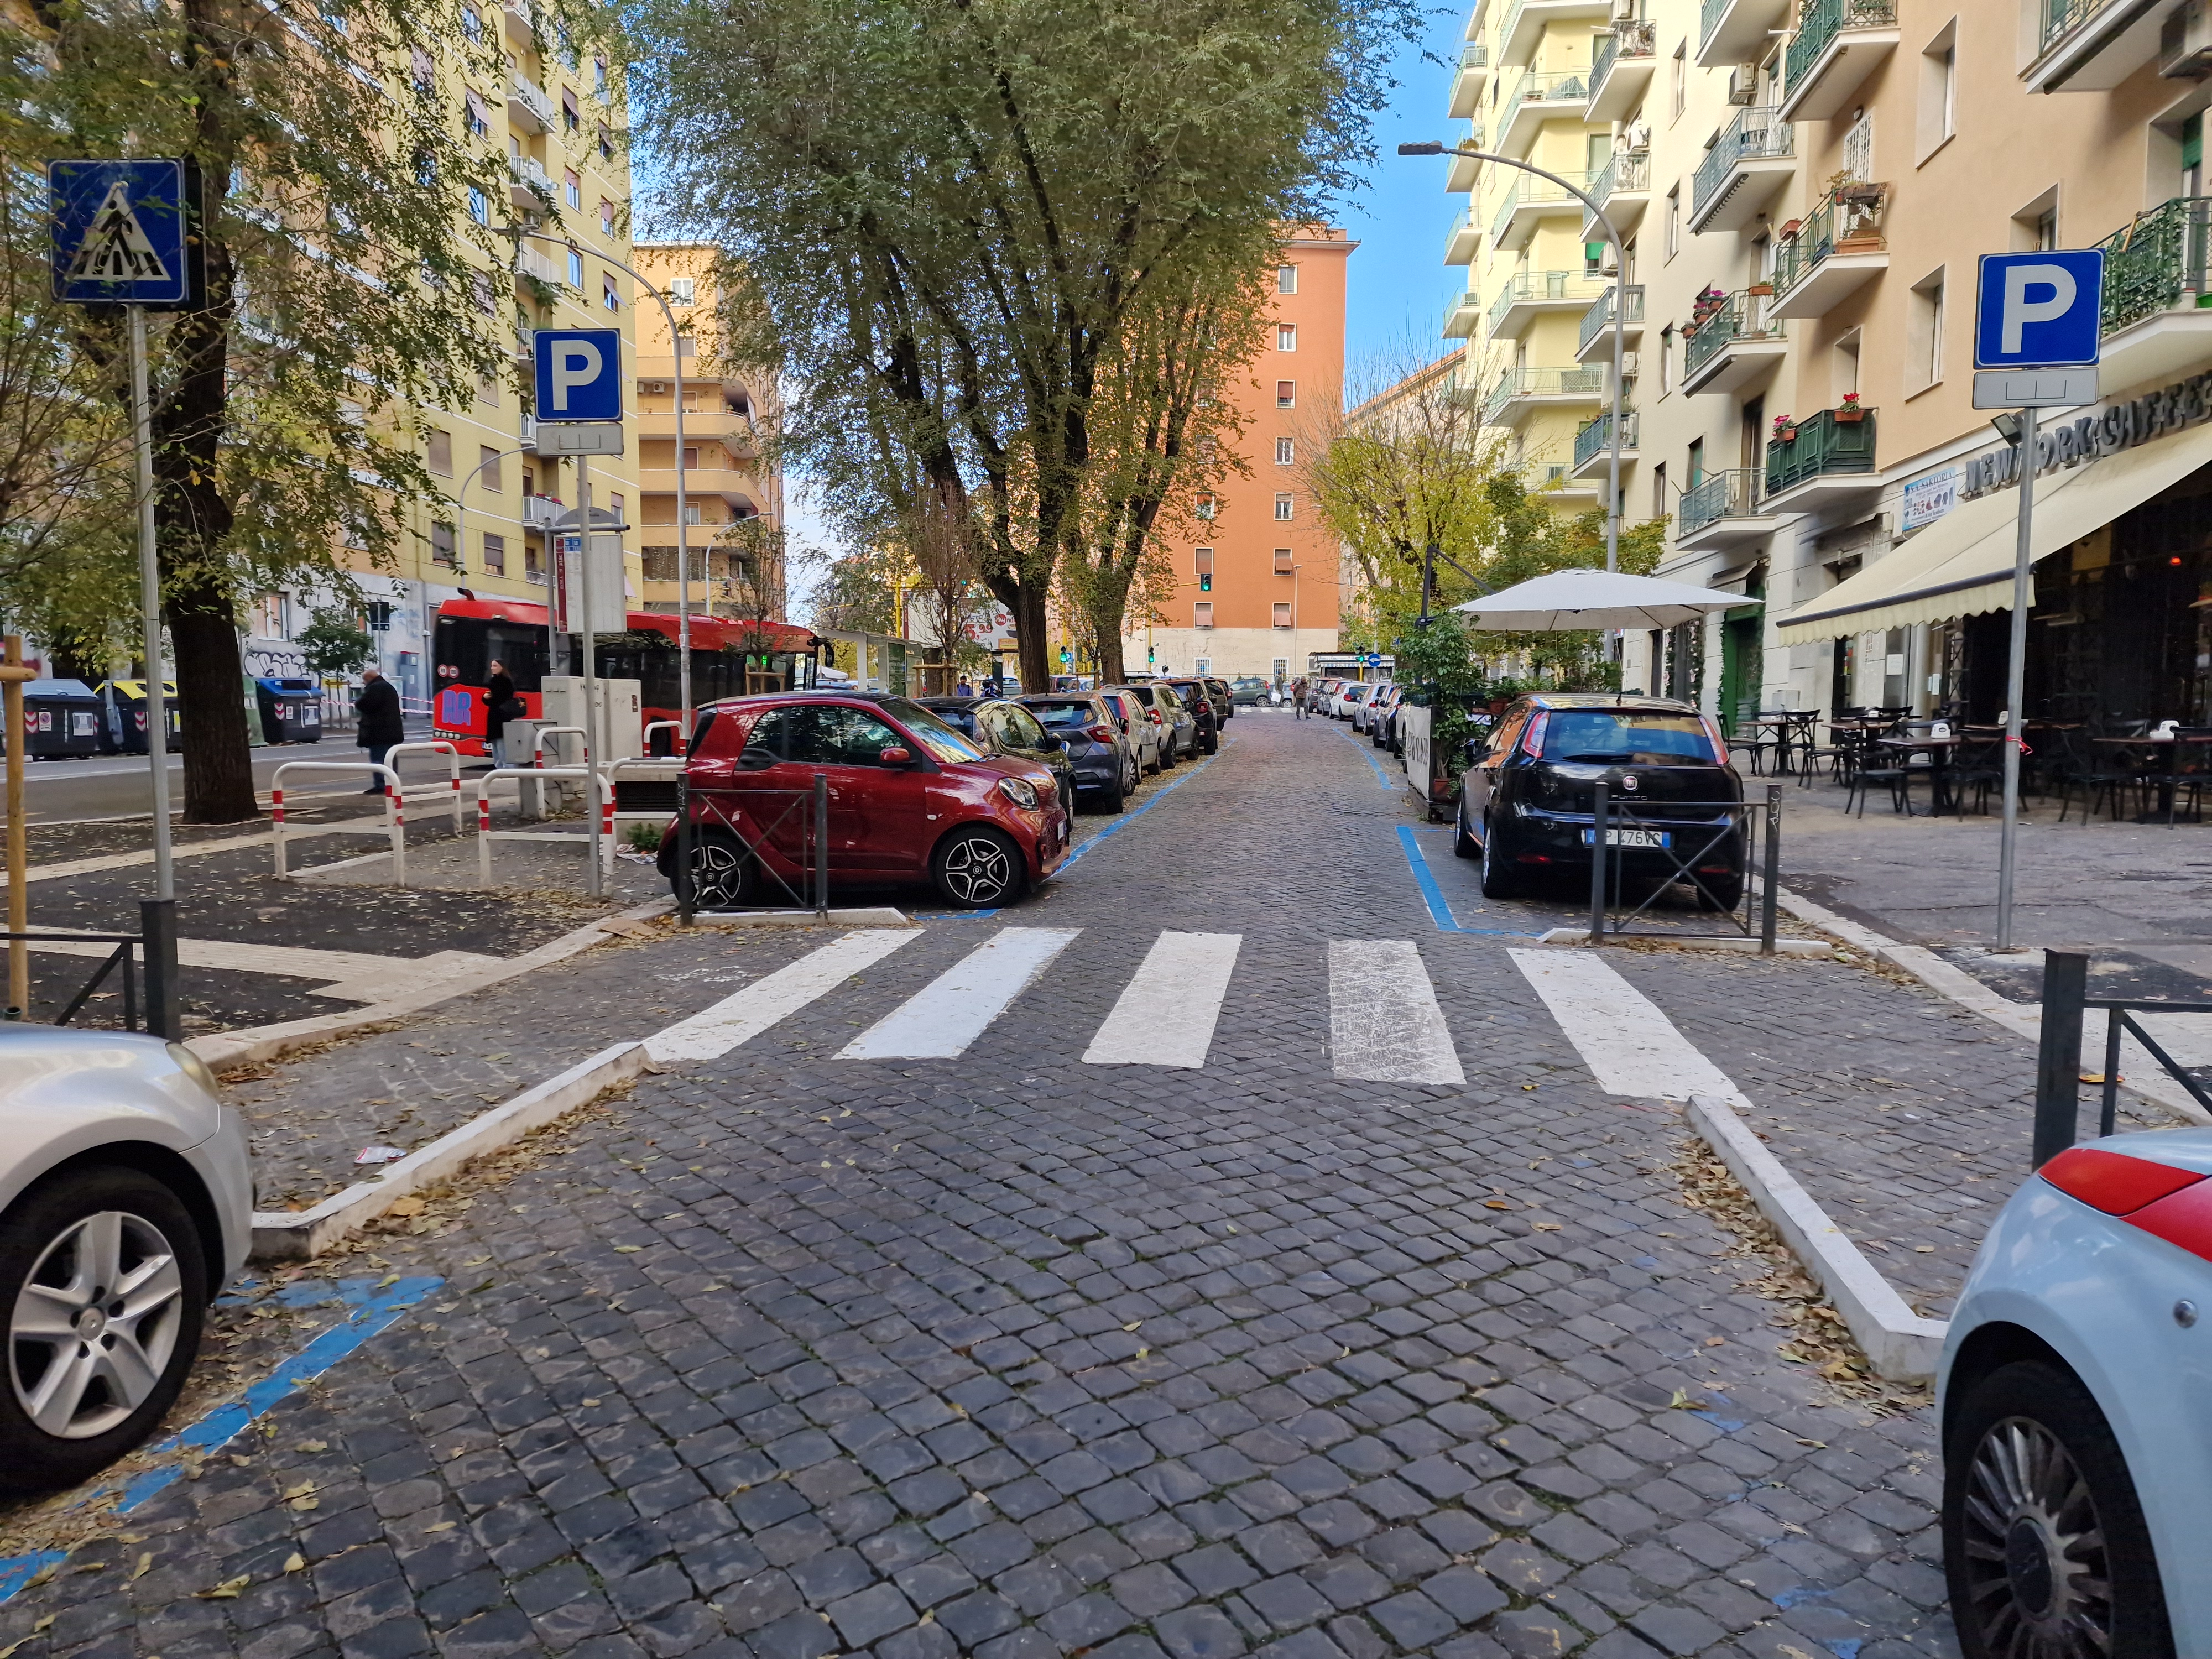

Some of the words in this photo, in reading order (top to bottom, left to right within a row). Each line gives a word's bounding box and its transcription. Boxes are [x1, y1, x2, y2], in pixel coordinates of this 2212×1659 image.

[2001, 264, 2077, 354] P
[551, 340, 603, 411] P
[1922, 471, 1952, 489] SARTORIA
[1965, 445, 2023, 493] NEW
[2034, 415, 2100, 473] ORK
